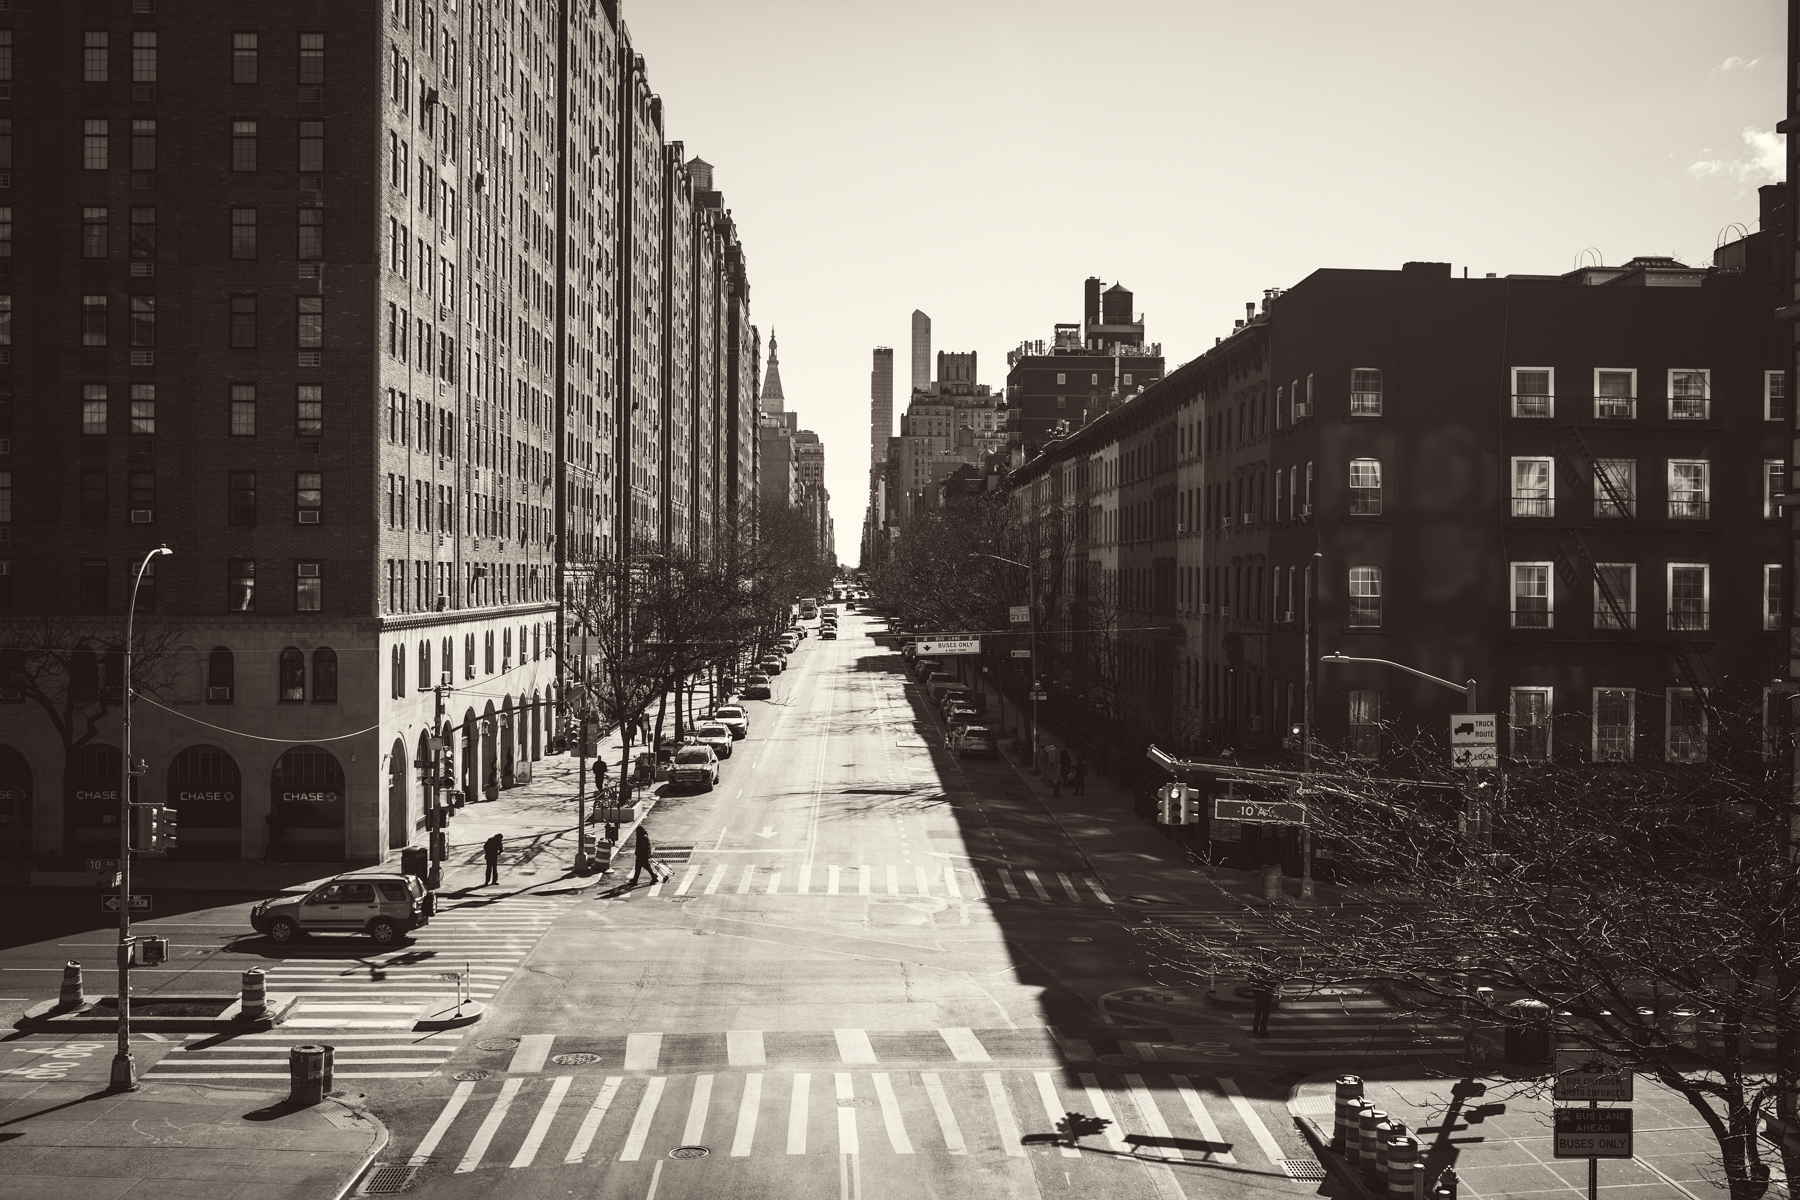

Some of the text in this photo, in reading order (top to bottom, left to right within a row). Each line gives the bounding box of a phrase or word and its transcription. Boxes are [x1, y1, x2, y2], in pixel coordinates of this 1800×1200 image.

[75, 791, 119, 800] CHASE
[180, 792, 219, 801] CHASE
[283, 792, 324, 801] CHASE
[1240, 805, 1254, 817] 10
[1599, 1112, 1626, 1121] LANE
[1575, 1123, 1610, 1133] AHEAD
[1559, 1138, 1627, 1150] BUSES ONLY
